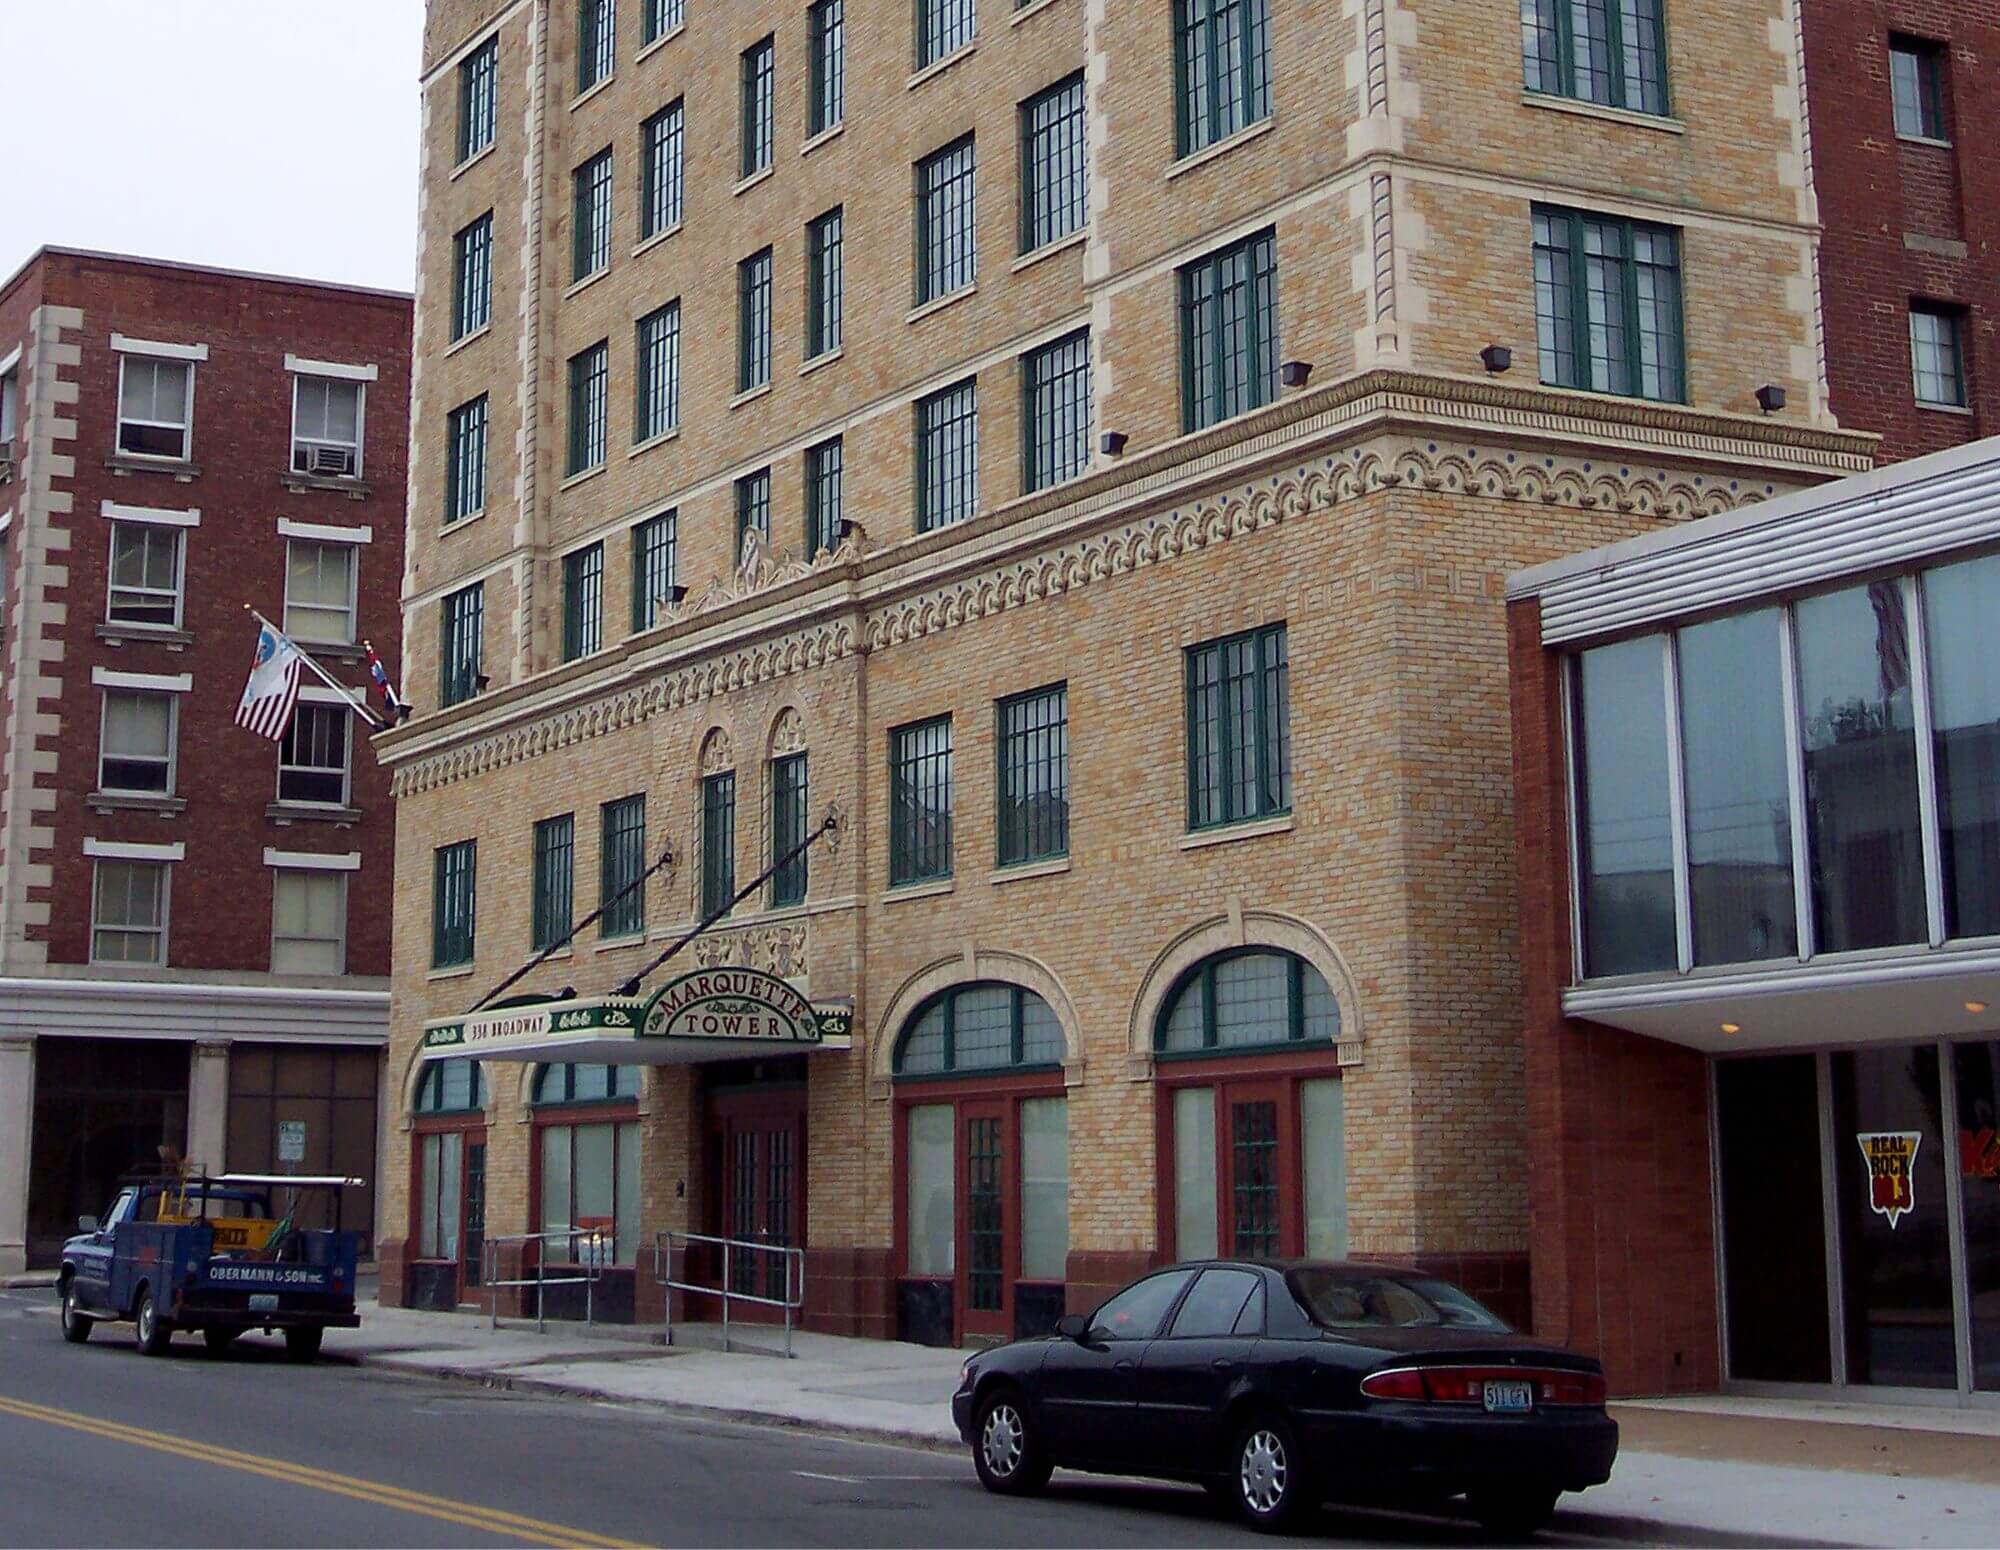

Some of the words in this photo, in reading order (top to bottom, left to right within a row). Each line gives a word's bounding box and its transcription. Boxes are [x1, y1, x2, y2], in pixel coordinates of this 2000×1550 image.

[659, 973, 805, 1021] MARQUETTE
[492, 1016, 544, 1037] BROADWAY
[685, 1014, 780, 1036] TOWER
[1872, 1136, 1906, 1153] REAL
[1871, 1154, 1909, 1176] ROCK
[209, 1266, 274, 1282] OBERMANN
[284, 1269, 307, 1283] SON
